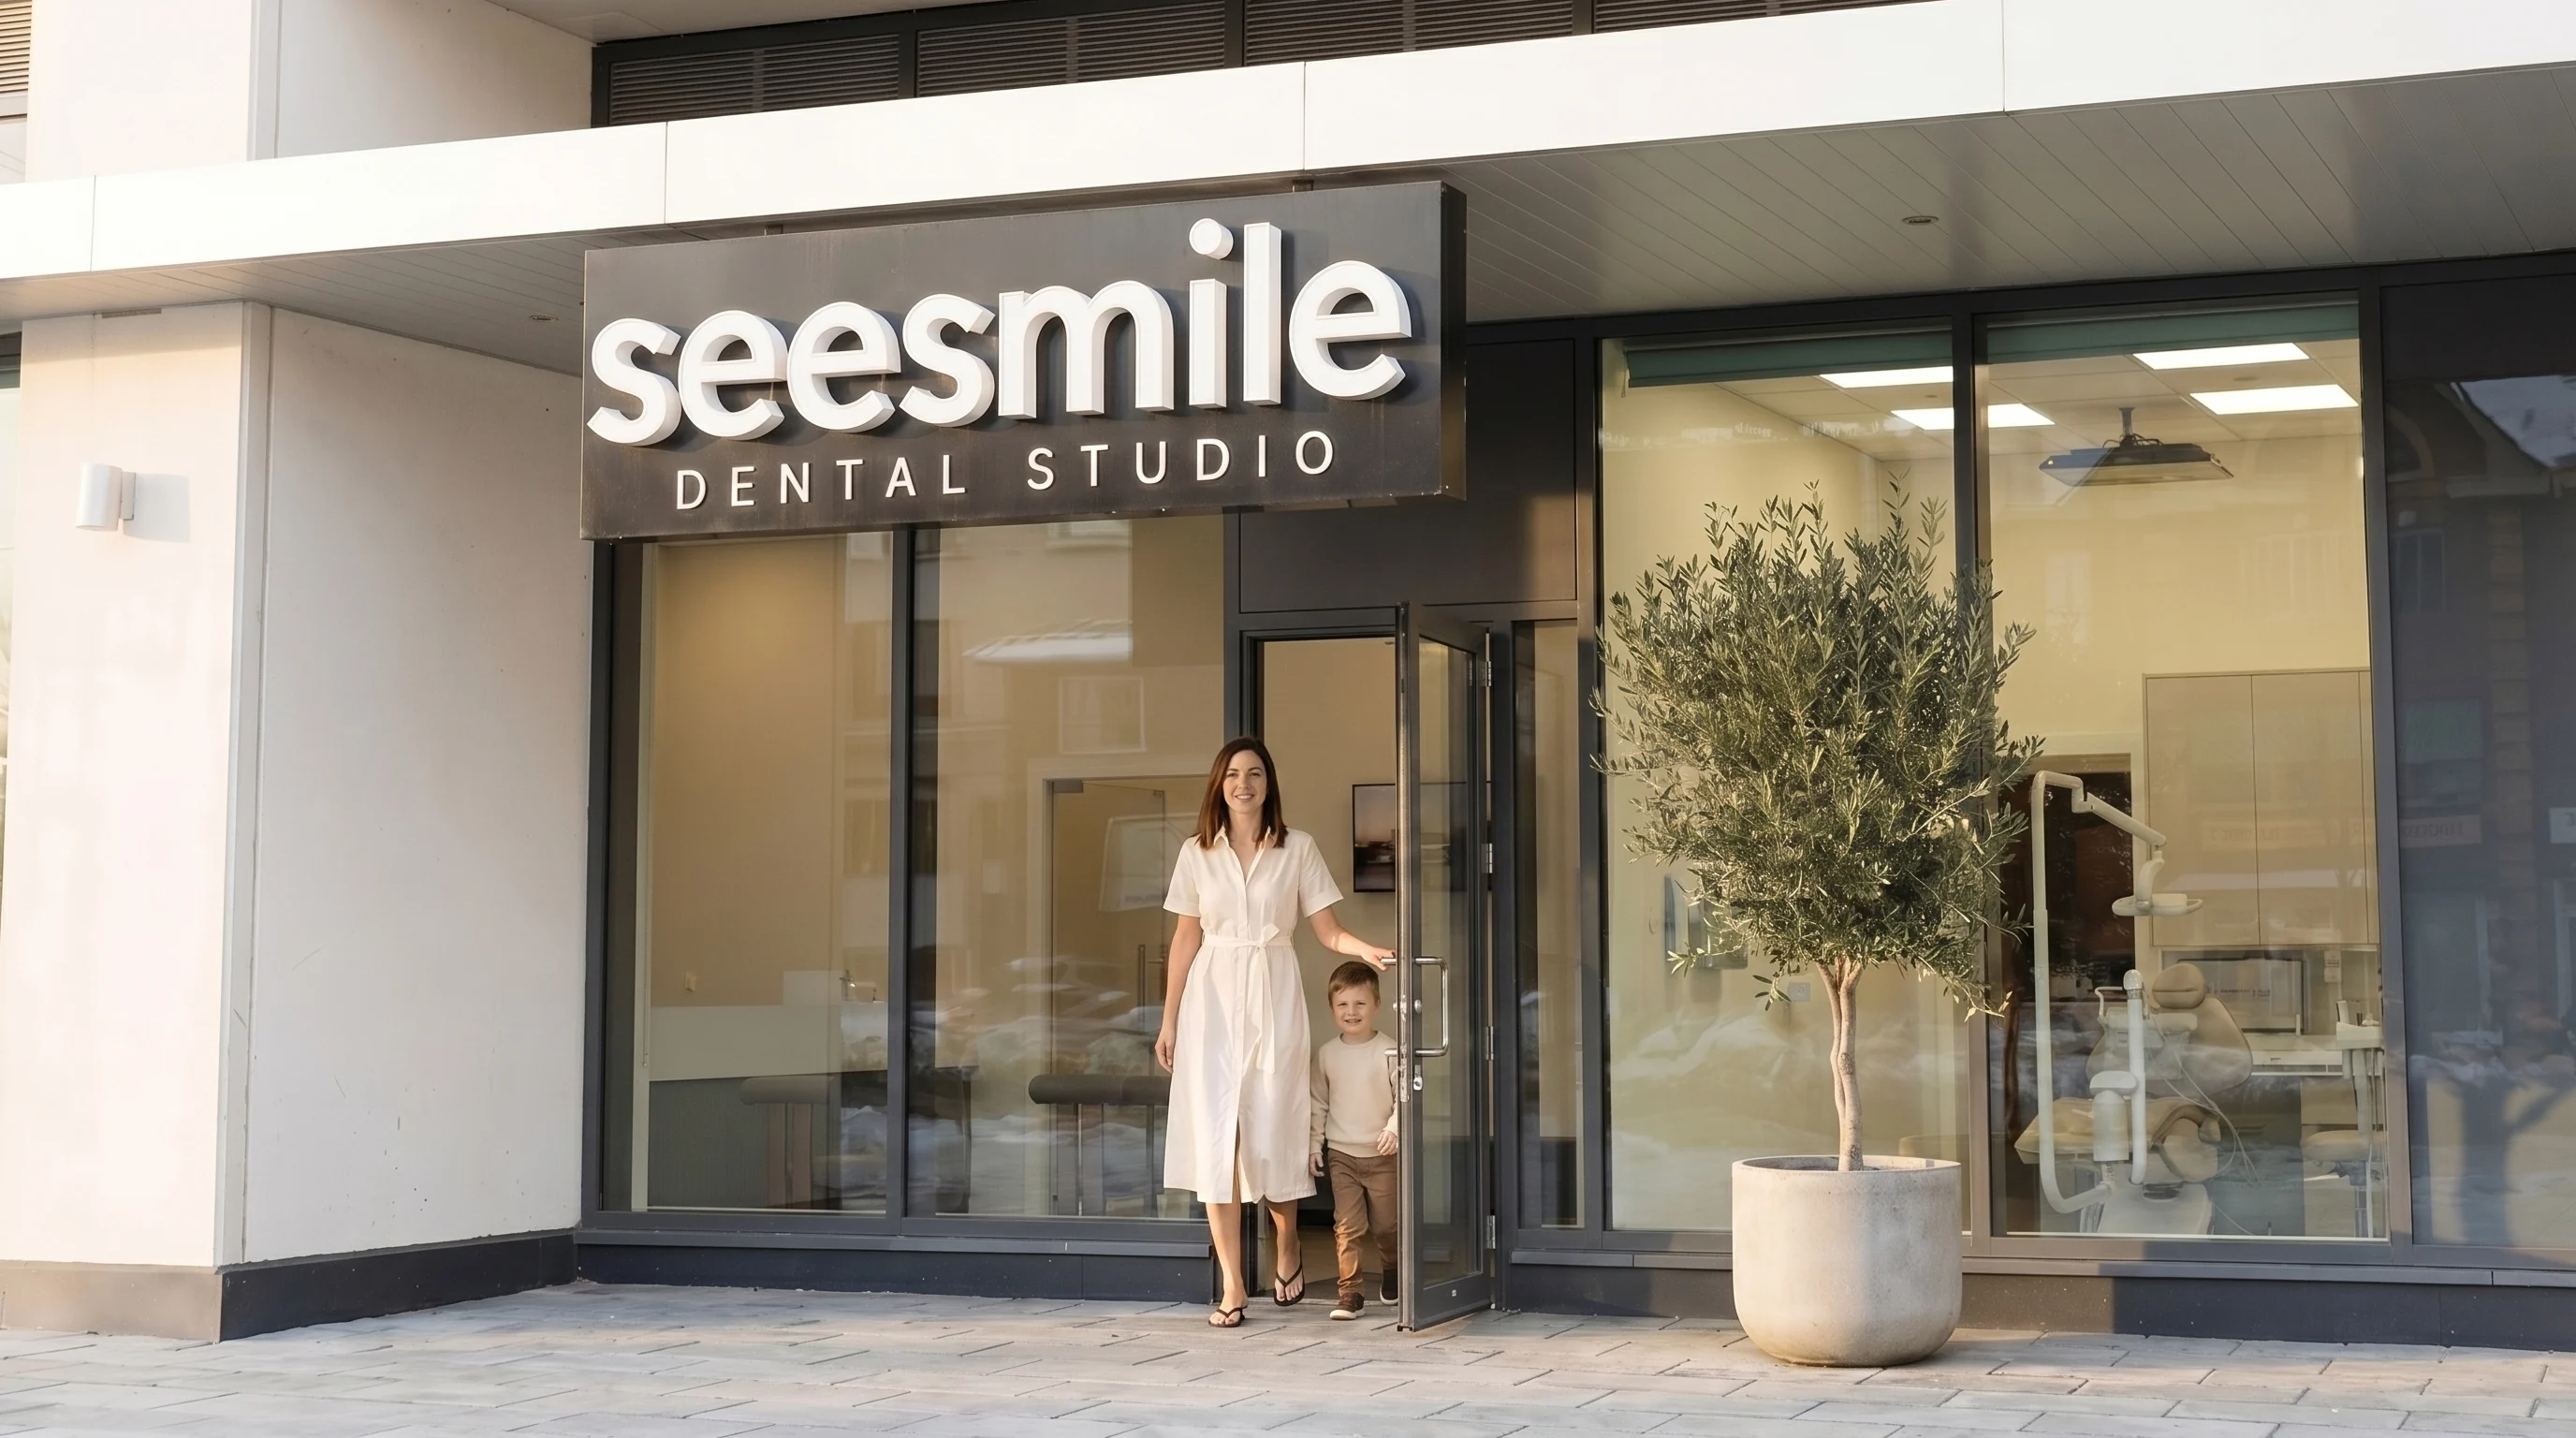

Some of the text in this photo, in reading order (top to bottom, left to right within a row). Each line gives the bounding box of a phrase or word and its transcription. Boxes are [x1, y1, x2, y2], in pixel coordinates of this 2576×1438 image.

[587, 218, 1412, 447] seesmile
[676, 430, 1334, 510] DENTAL STUDIO
